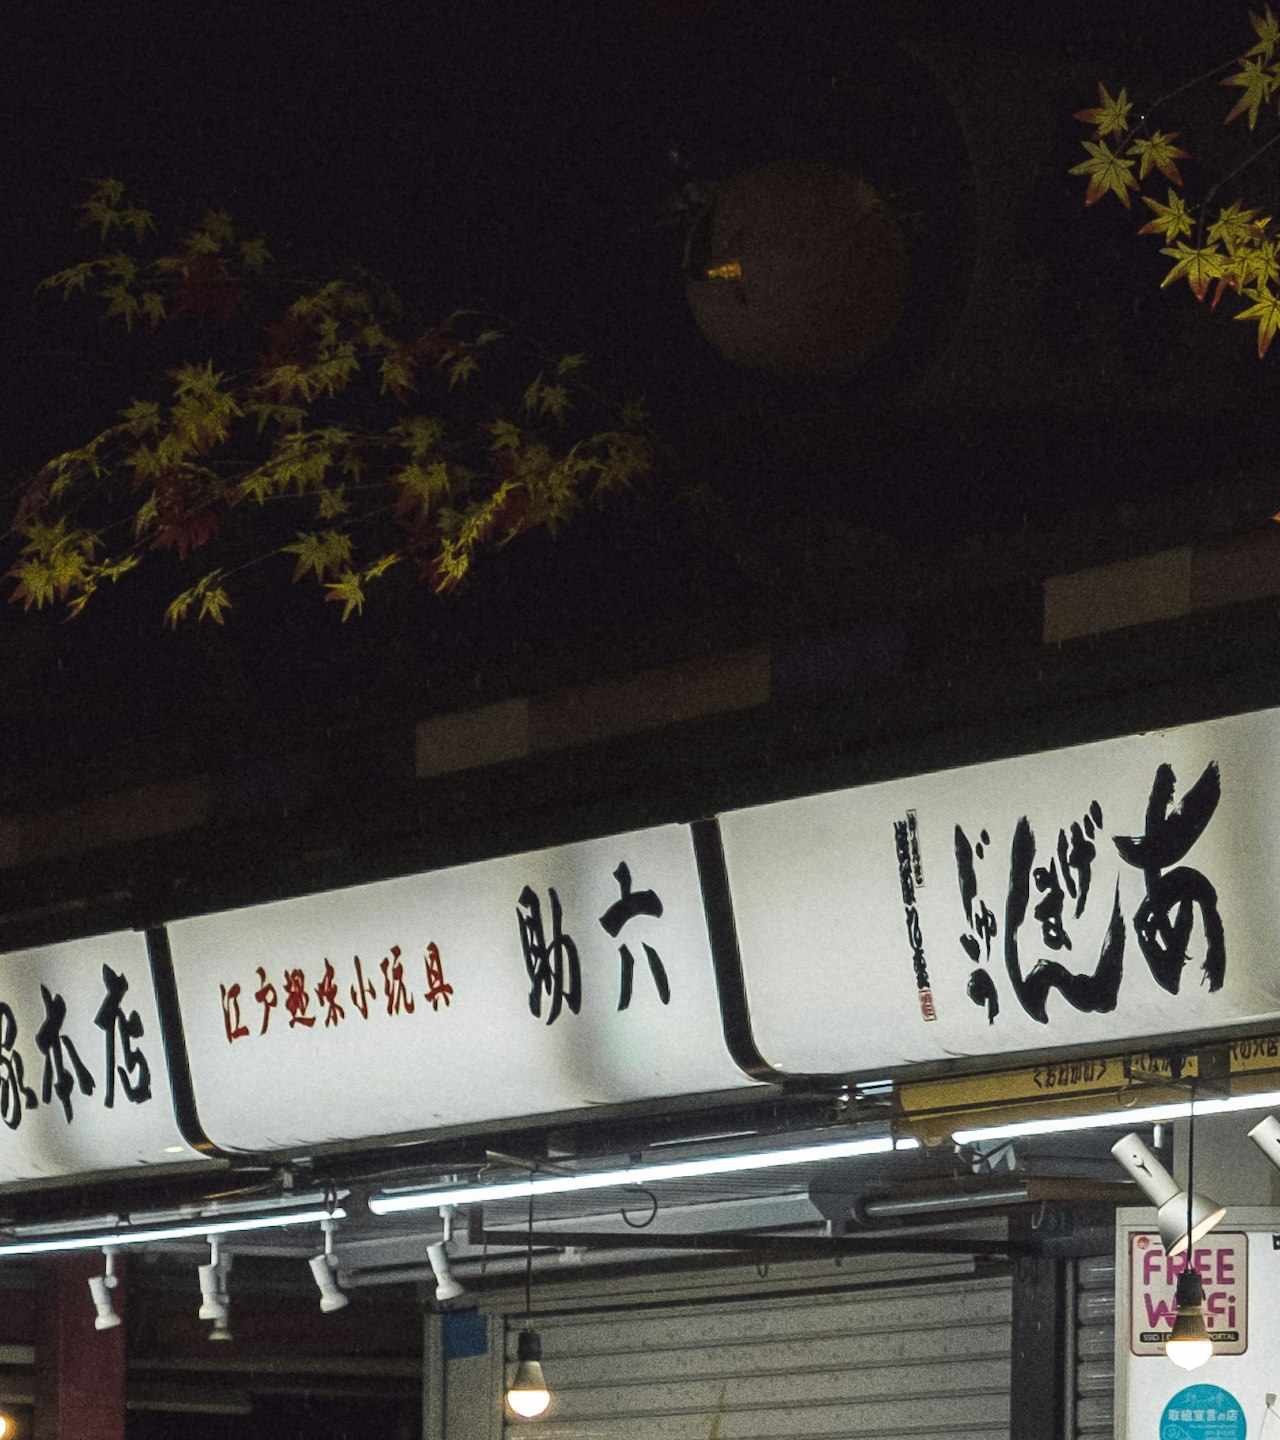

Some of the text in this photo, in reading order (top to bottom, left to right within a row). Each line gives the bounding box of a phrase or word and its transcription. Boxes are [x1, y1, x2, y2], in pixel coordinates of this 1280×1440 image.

[516, 861, 671, 1026] 助六
[1143, 1249, 1236, 1285] FREE
[1143, 1292, 1236, 1328] WFi
